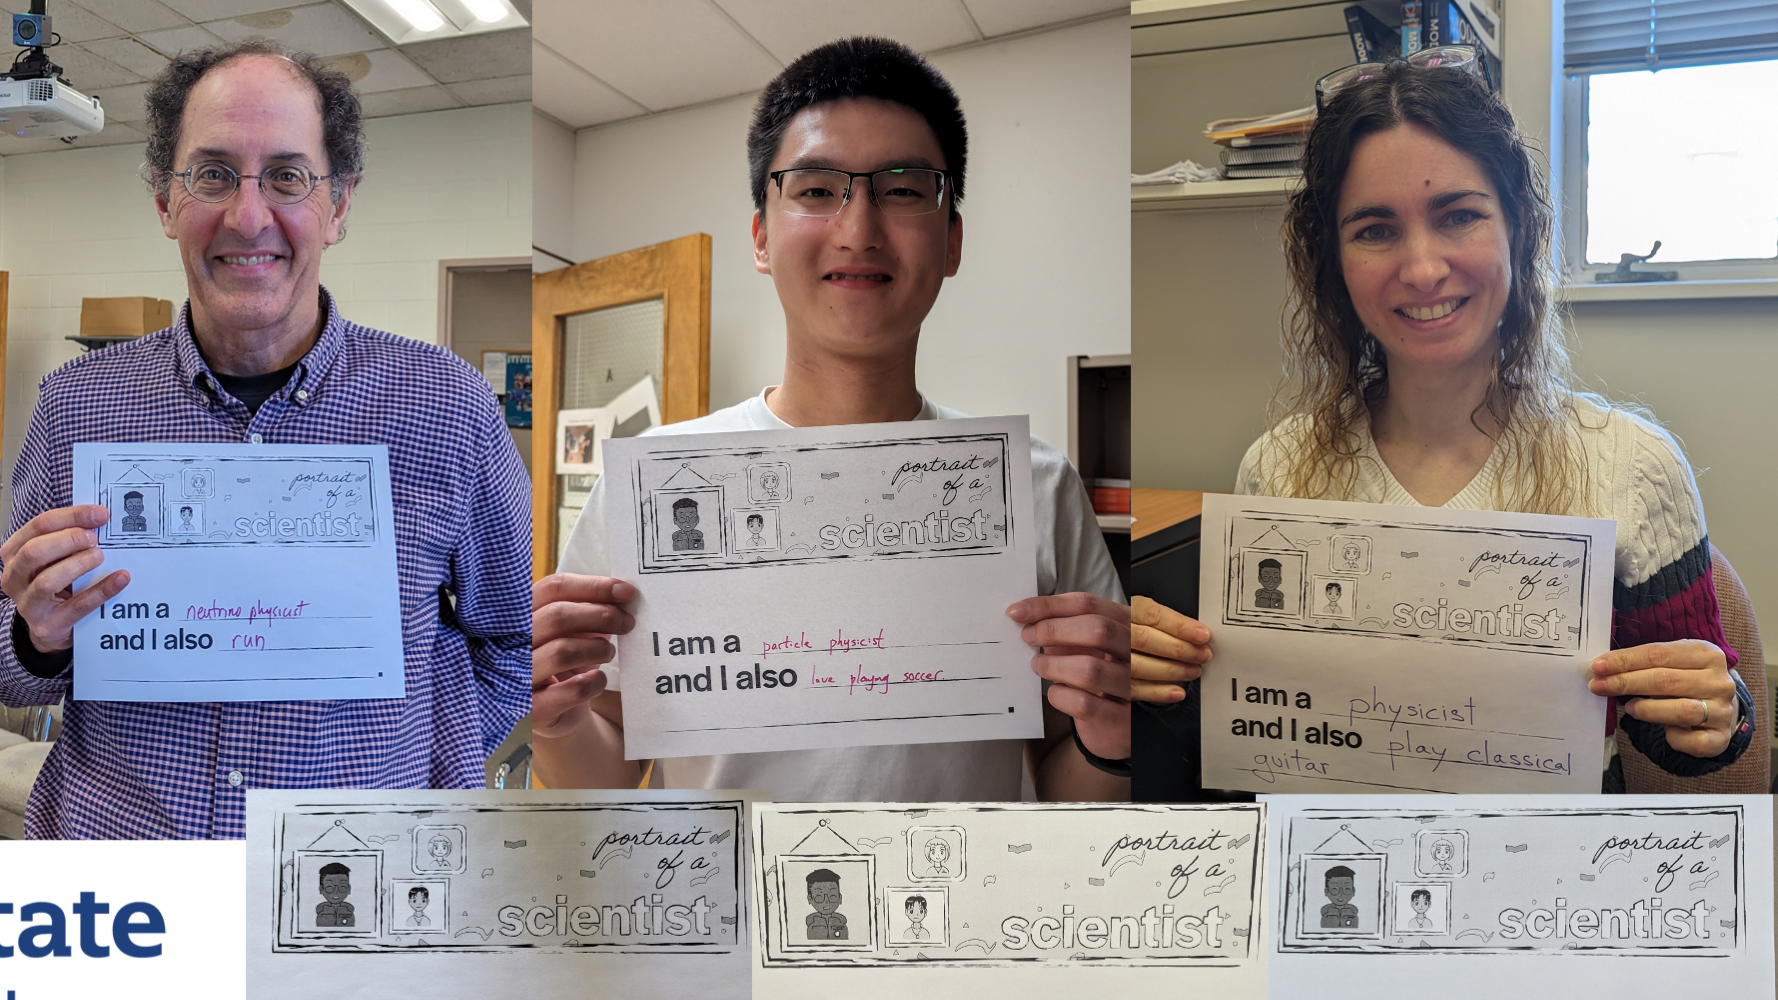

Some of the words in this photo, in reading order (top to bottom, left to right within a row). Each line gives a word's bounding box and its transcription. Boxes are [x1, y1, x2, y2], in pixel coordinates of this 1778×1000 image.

[186, 599, 242, 620] neutrino
[232, 634, 265, 651] run
[763, 631, 813, 659] particle
[829, 628, 885, 655] physicist
[811, 664, 836, 684] love
[1349, 685, 1477, 732] physicist
[1252, 748, 1331, 784] guitar
[1385, 729, 1448, 772] play
[1466, 739, 1572, 776] classical
[592, 826, 711, 861] portrait
[656, 853, 683, 889] of
[689, 858, 710, 872] a
[498, 893, 713, 938] scientist
